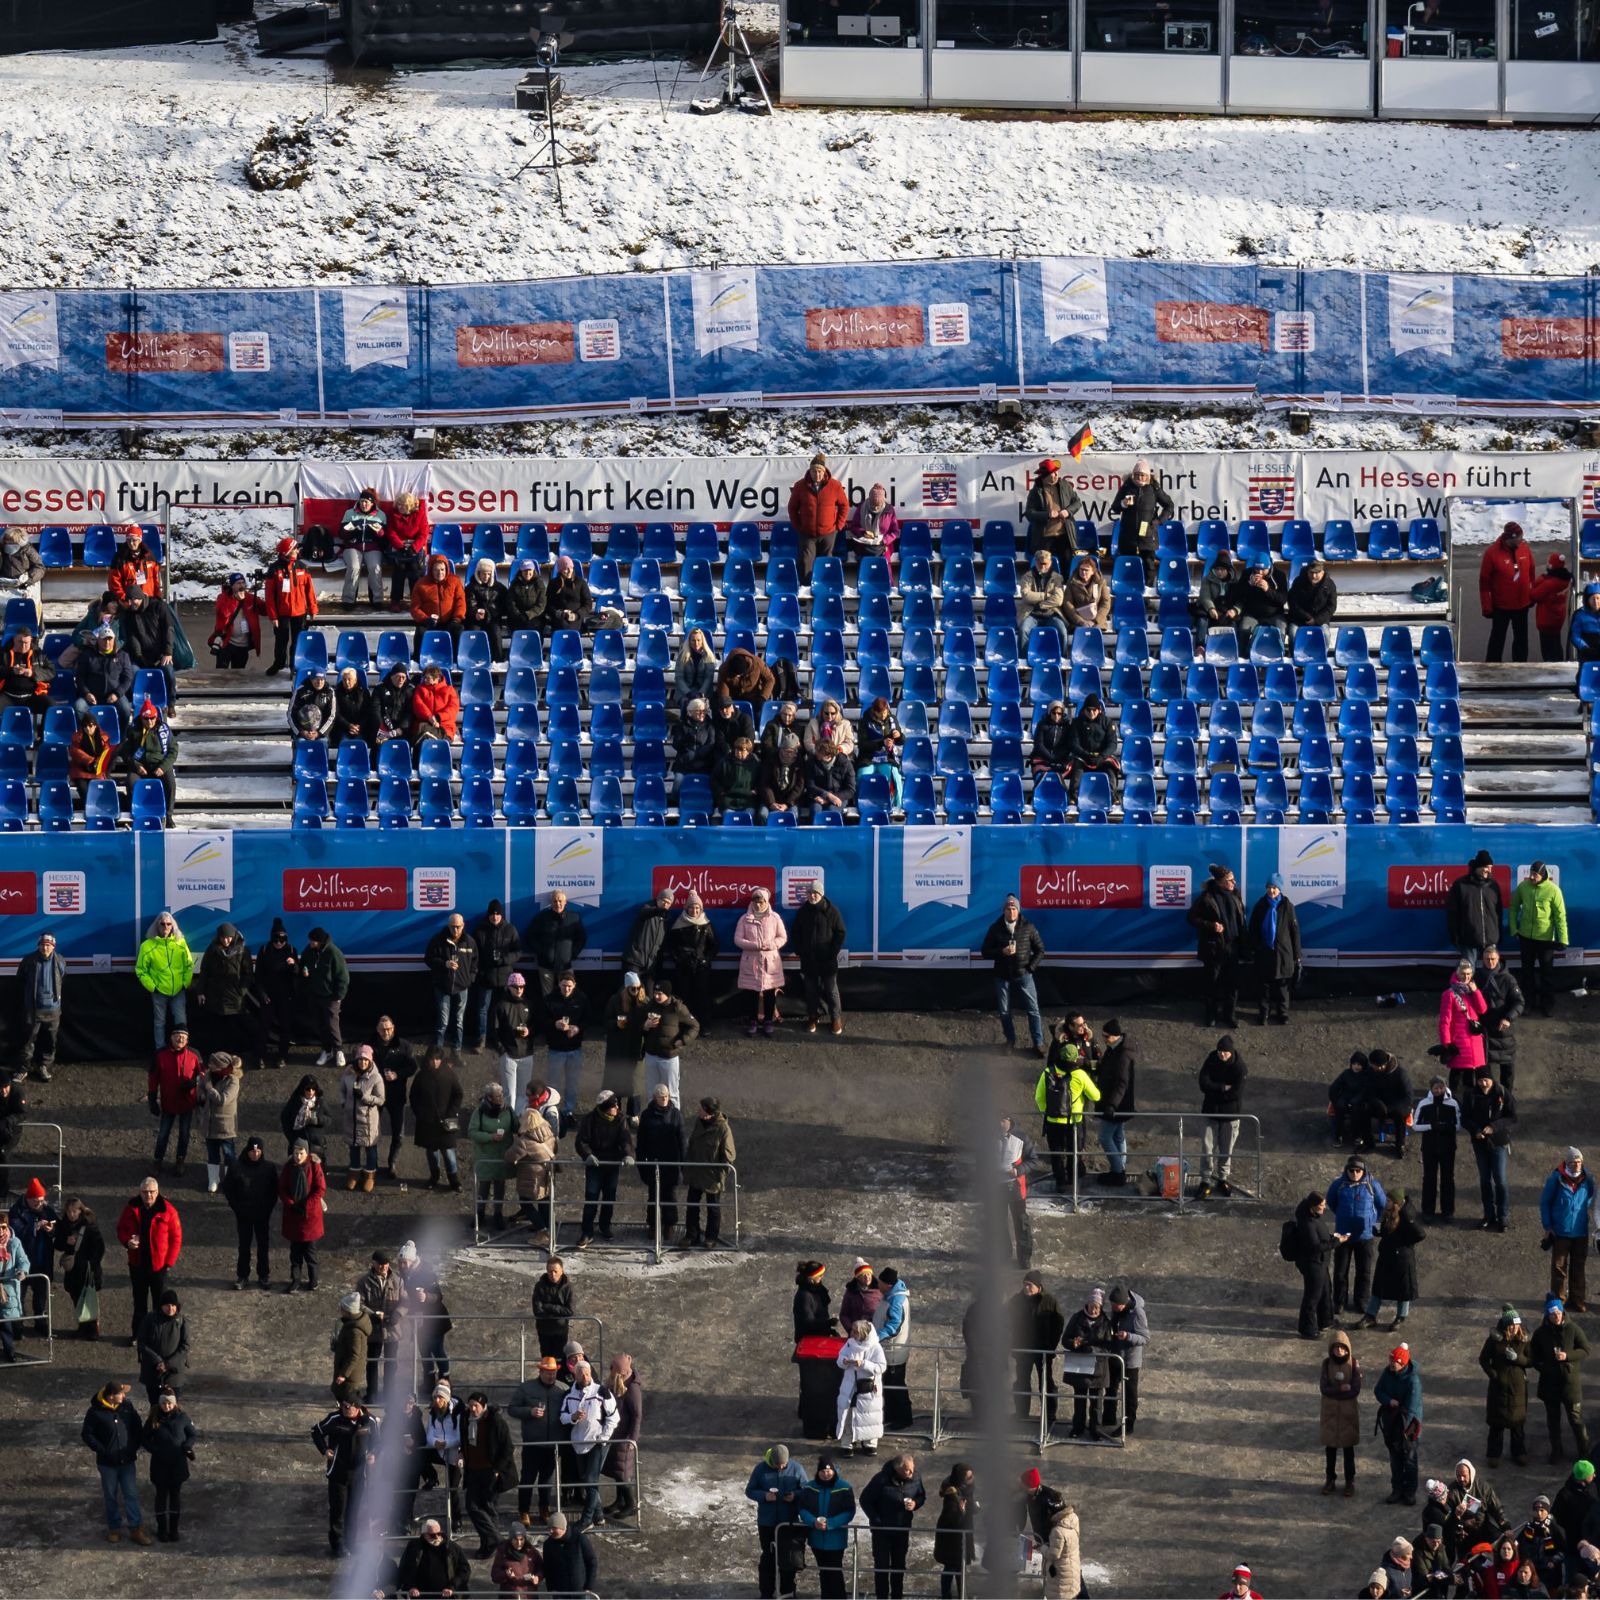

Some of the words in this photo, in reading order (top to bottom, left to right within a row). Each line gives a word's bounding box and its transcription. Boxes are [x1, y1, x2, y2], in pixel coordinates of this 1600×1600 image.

[821, 312, 912, 343] Willingen
[1056, 313, 1102, 321] WILLINGEN
[1171, 309, 1257, 338] Willingen
[705, 325, 752, 334] WILLINGEN
[1401, 327, 1447, 335] WILLINGEN
[121, 337, 211, 367] Willingen
[356, 341, 403, 349] WILLINGEN
[472, 329, 562, 360] Willingen
[921, 463, 957, 471] HESSEN
[1249, 464, 1294, 473] HESSEN
[1316, 467, 1349, 488] An
[1360, 466, 1456, 488] Hessen
[1466, 466, 1531, 488] führt
[981, 470, 1014, 491] An
[1025, 470, 1121, 491] Hssen
[1151, 469, 1197, 490] hrt
[117, 481, 202, 511] führt
[213, 482, 283, 505] kein
[428, 489, 518, 512] ssen
[530, 480, 614, 511] führt
[625, 479, 695, 510] kein
[706, 479, 780, 516] Weg
[1083, 500, 1120, 522] We
[1354, 497, 1407, 519] kein
[787, 869, 818, 877] HESSEN
[915, 879, 963, 887] WILLINGEN
[1155, 868, 1186, 876] HESSEN
[299, 872, 393, 906] Willingen
[1036, 870, 1130, 904] Willingen
